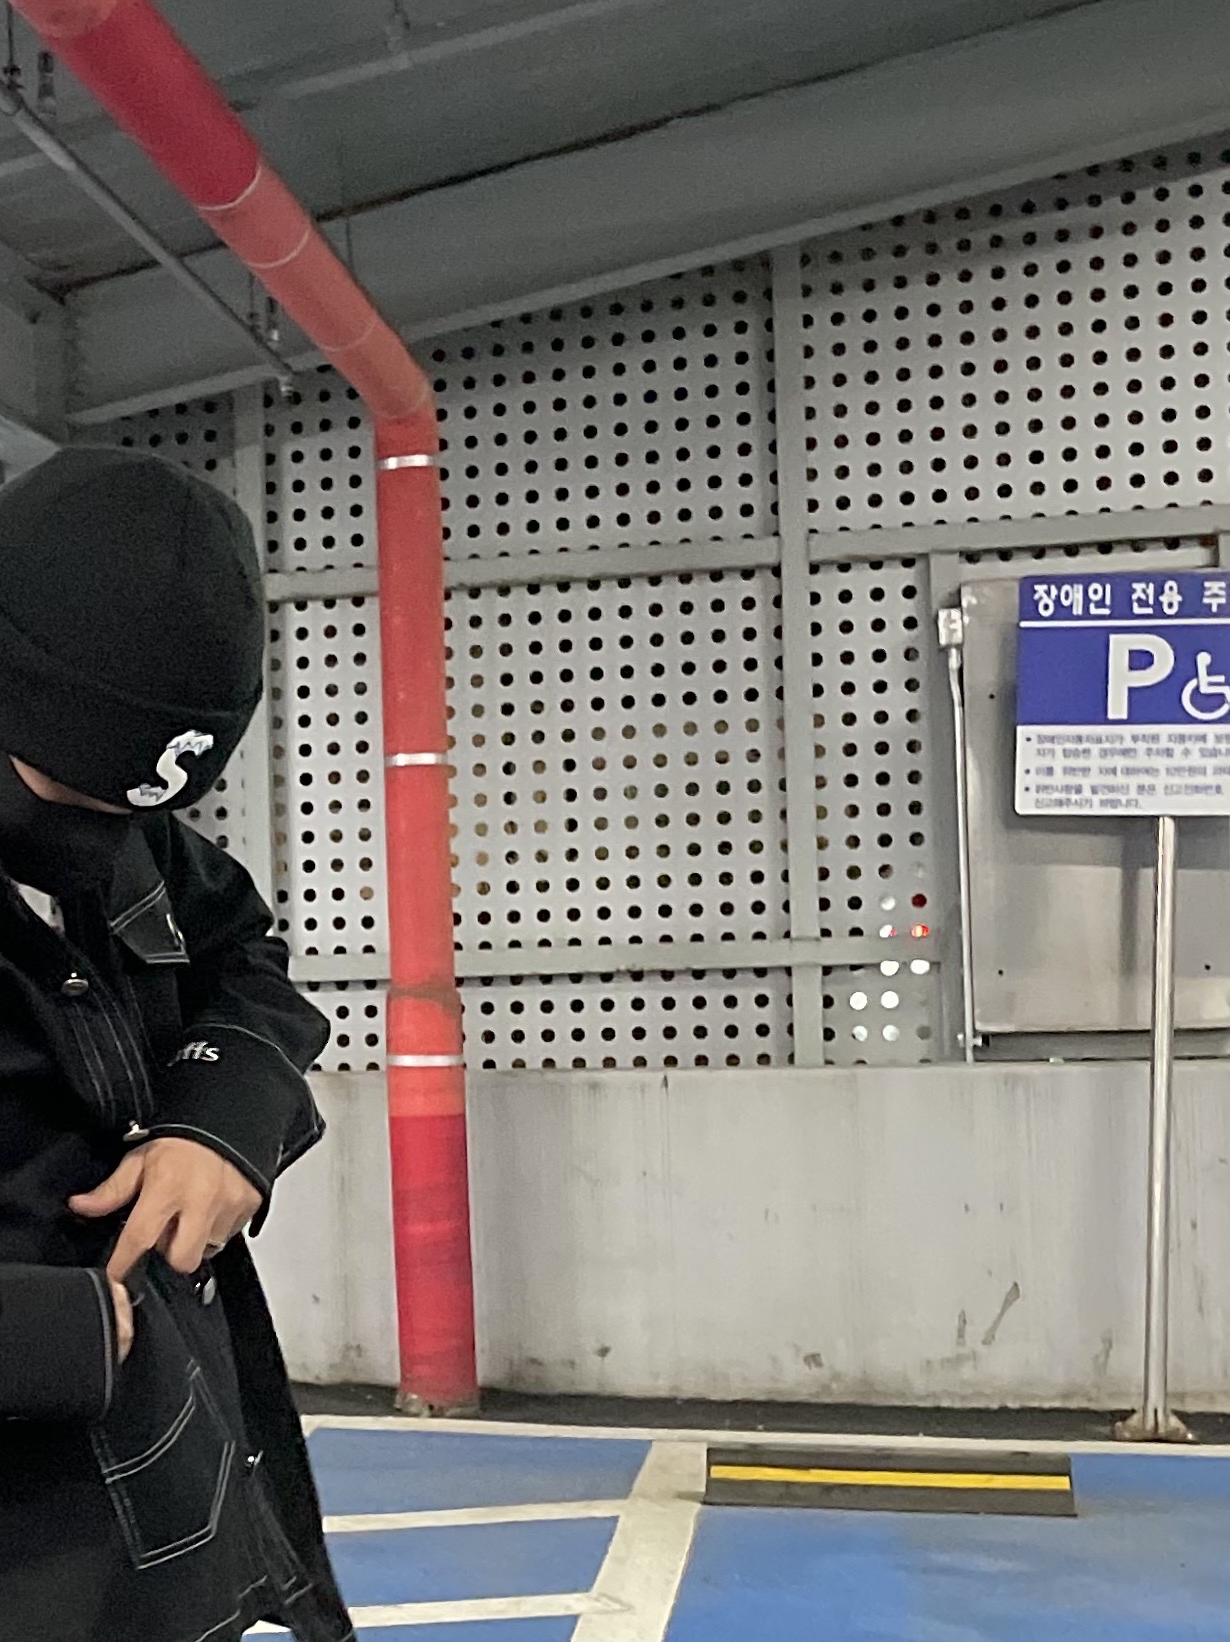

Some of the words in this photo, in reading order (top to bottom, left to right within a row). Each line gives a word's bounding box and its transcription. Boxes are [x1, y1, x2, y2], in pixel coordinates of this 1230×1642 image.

[1033, 583, 1112, 617] 장애인
[1131, 580, 1183, 615] 전용
[1106, 633, 1175, 720] P
